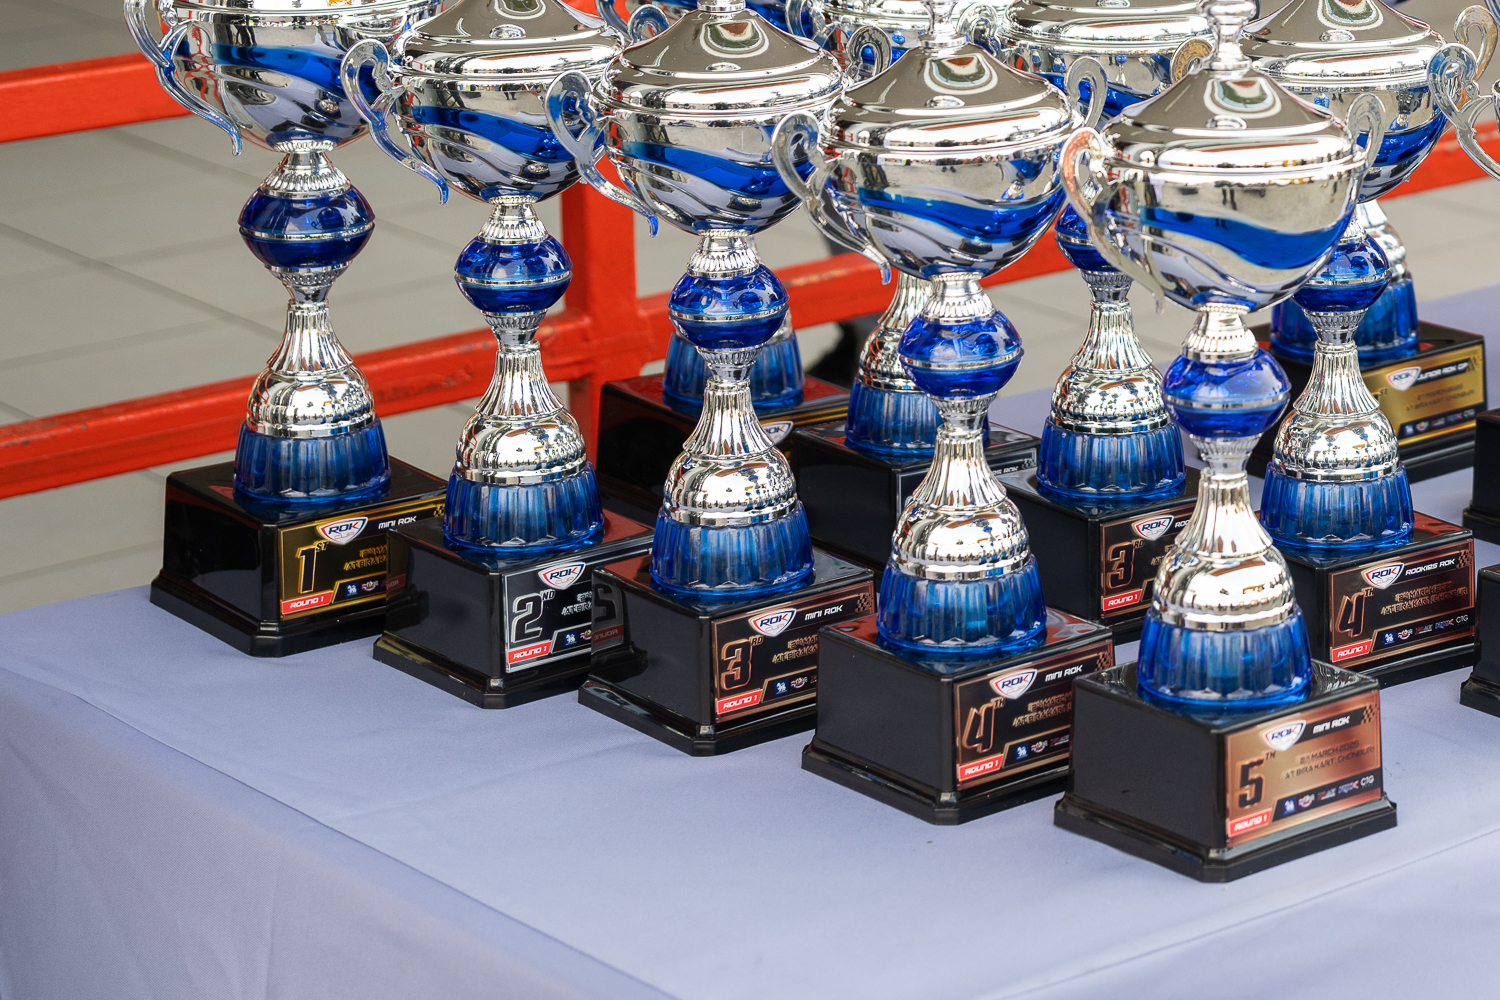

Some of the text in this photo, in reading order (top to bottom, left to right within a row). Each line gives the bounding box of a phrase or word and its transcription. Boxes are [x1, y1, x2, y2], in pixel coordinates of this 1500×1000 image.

[329, 521, 360, 535] ROK
[378, 515, 417, 529] MINI ROK
[1142, 519, 1168, 531] ROK
[549, 567, 578, 580] ROK
[1371, 566, 1398, 580] ROK
[1405, 558, 1455, 576] ROOKIES ROK
[290, 597, 319, 609] ROUND
[1108, 595, 1133, 606] ROUND
[805, 605, 843, 620] MINI ROK
[760, 613, 788, 627] ROK
[513, 649, 541, 659] ROUND
[1337, 647, 1363, 657] ROUND
[1045, 665, 1083, 682] MINI ROK
[1002, 674, 1029, 688] ROK
[723, 697, 753, 709] ROUND
[1313, 715, 1350, 734] MINI ROK
[1271, 726, 1297, 740] ROK
[964, 761, 993, 775] ROUND
[1234, 816, 1262, 831] ROUND
